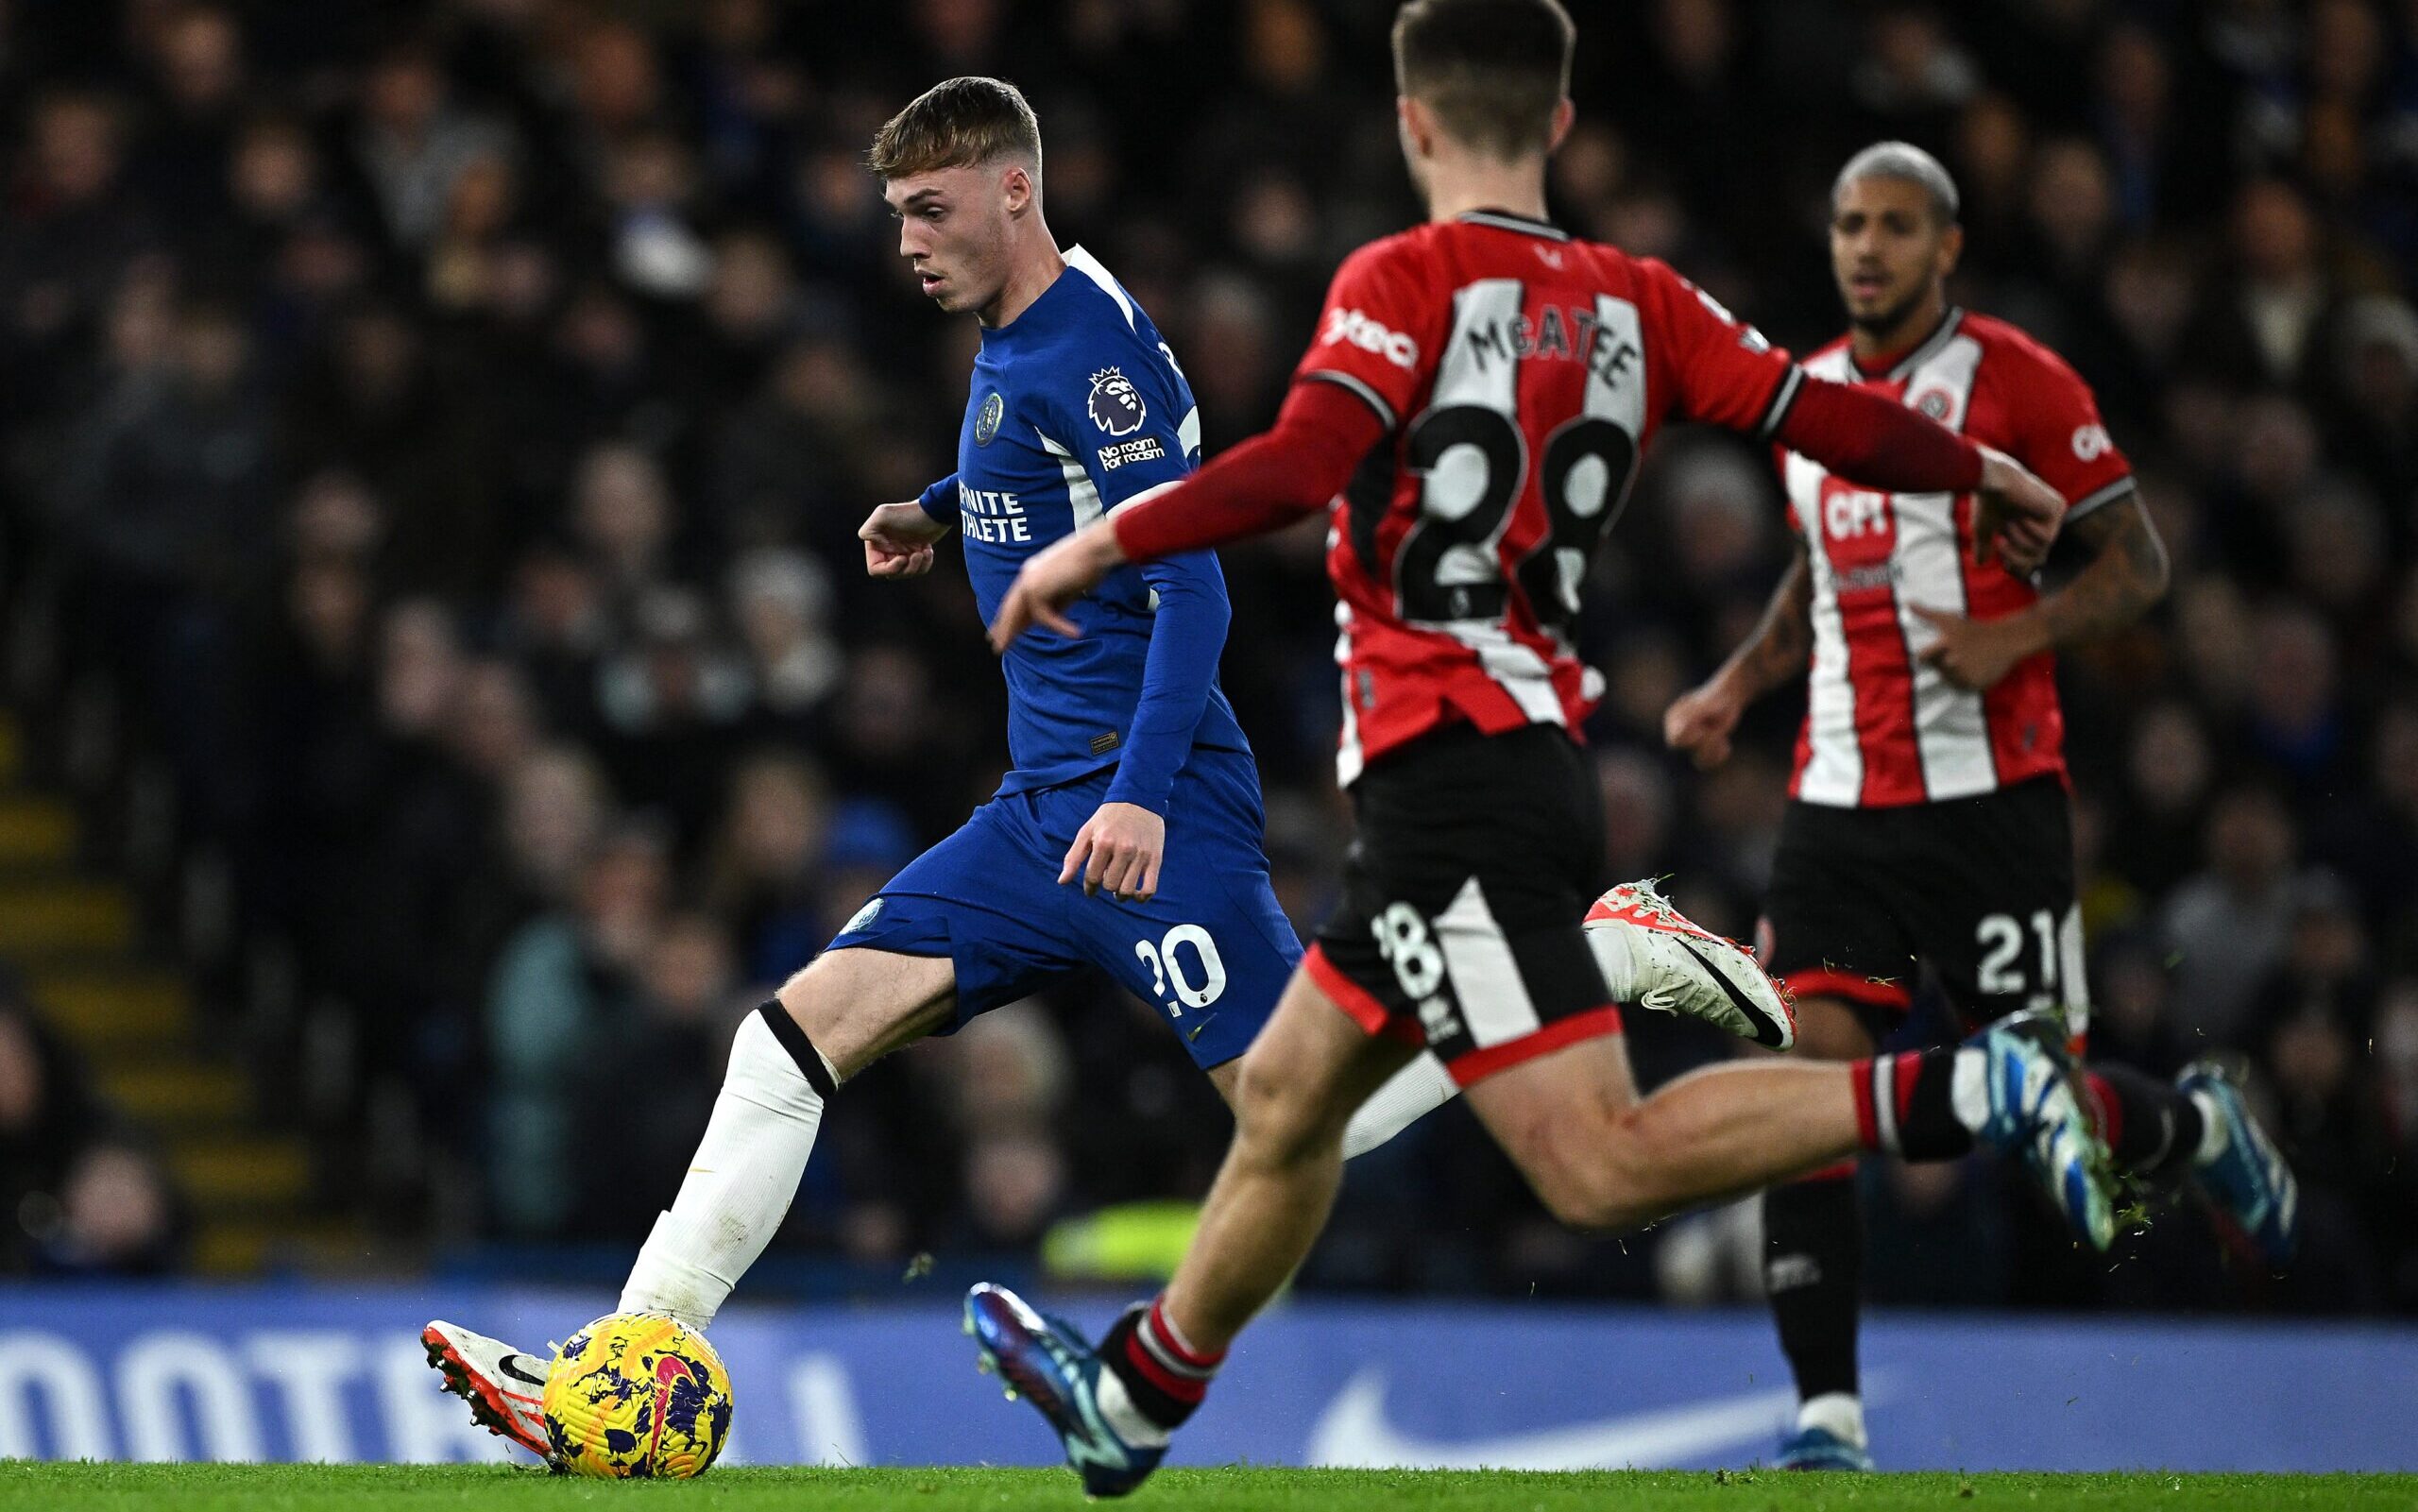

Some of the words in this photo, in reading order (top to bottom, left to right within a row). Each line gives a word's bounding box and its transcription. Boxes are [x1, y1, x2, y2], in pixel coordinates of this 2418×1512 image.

[1097, 446, 1119, 461] No
[1119, 437, 1156, 453] room
[1123, 447, 1166, 464] racism
[1392, 403, 1642, 637] 28
[1134, 924, 1227, 1018] 20
[1975, 909, 2056, 994] 21
